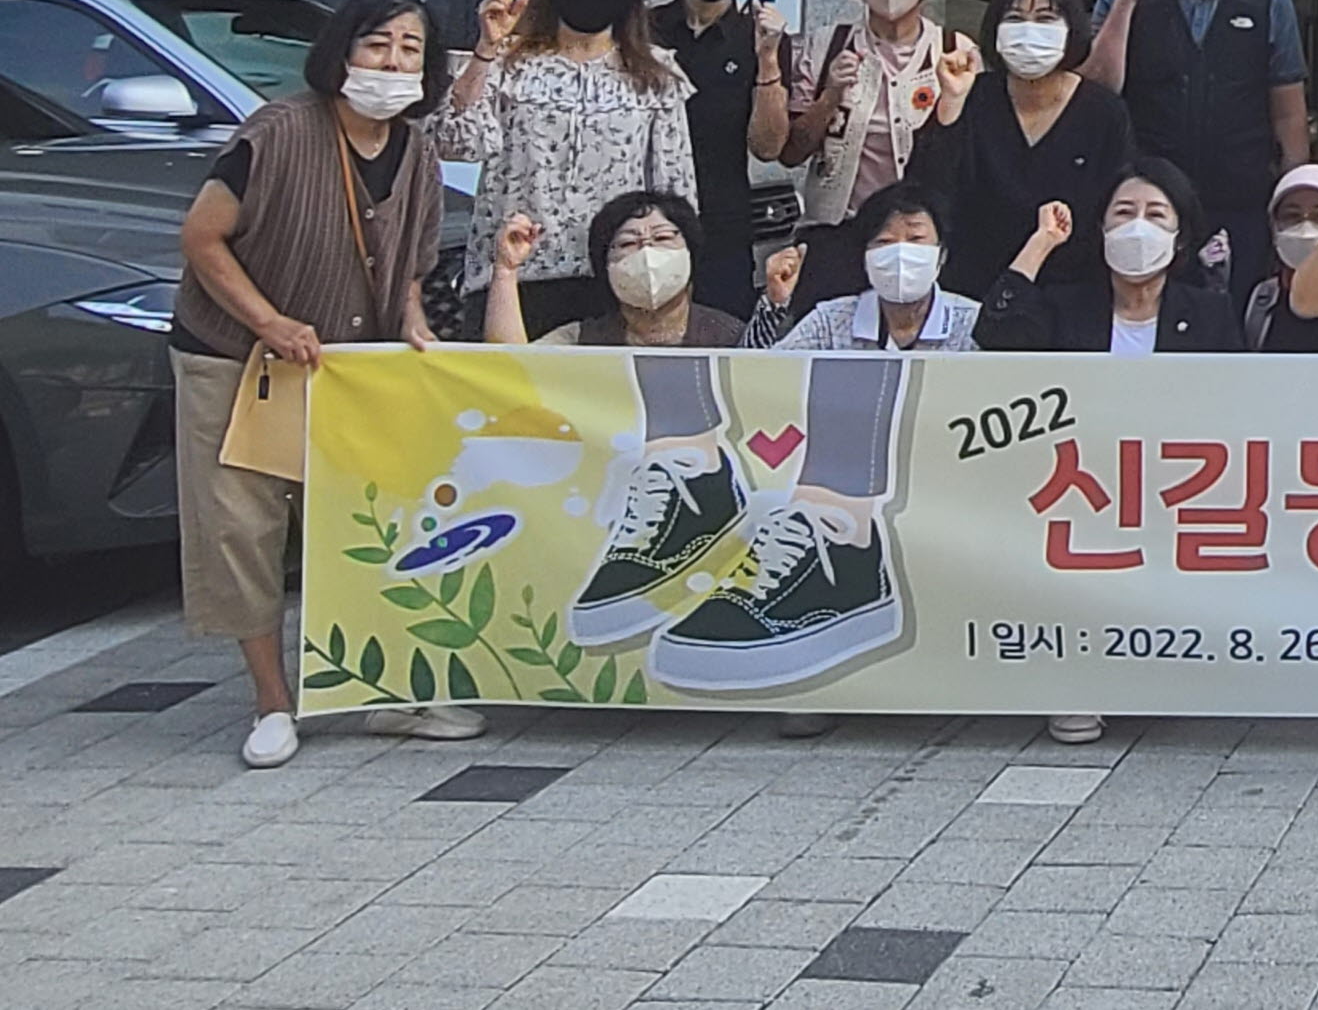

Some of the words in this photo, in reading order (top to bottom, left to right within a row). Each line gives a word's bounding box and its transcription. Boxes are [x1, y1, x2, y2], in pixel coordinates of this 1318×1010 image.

[948, 387, 1076, 460] 2022
[991, 622, 1064, 660] 일시
[1104, 627, 1216, 662] 2022.
[1229, 628, 1265, 662] 8.
